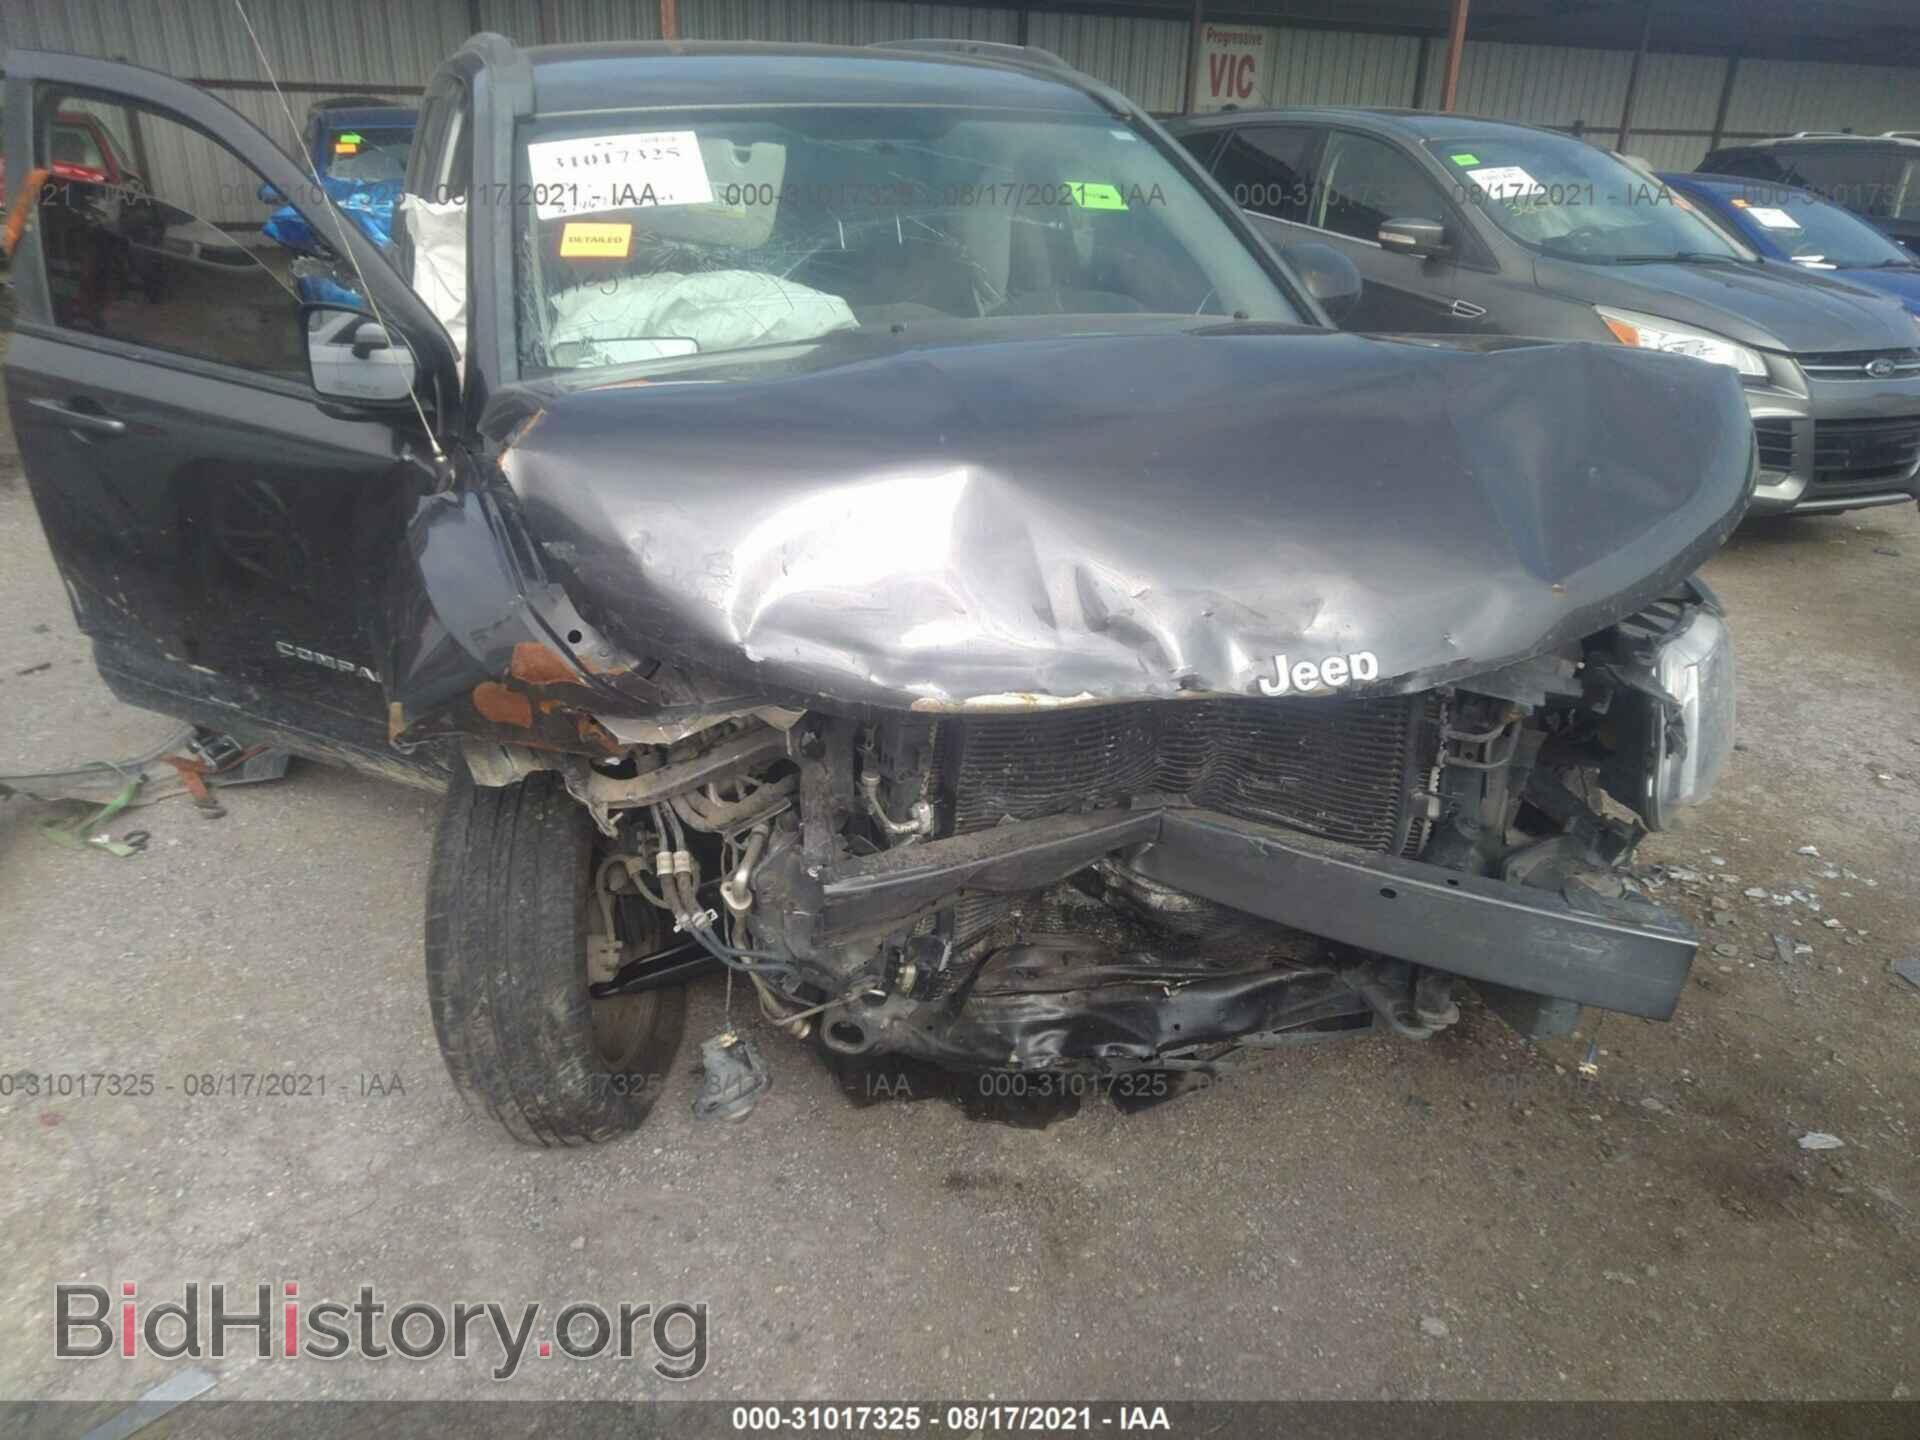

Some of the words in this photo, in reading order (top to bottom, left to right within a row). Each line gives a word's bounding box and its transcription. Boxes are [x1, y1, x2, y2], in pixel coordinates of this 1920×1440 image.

[1209, 52, 1256, 98] VIC
[567, 235, 624, 245] DETAILED
[1258, 651, 1378, 697] Jeep
